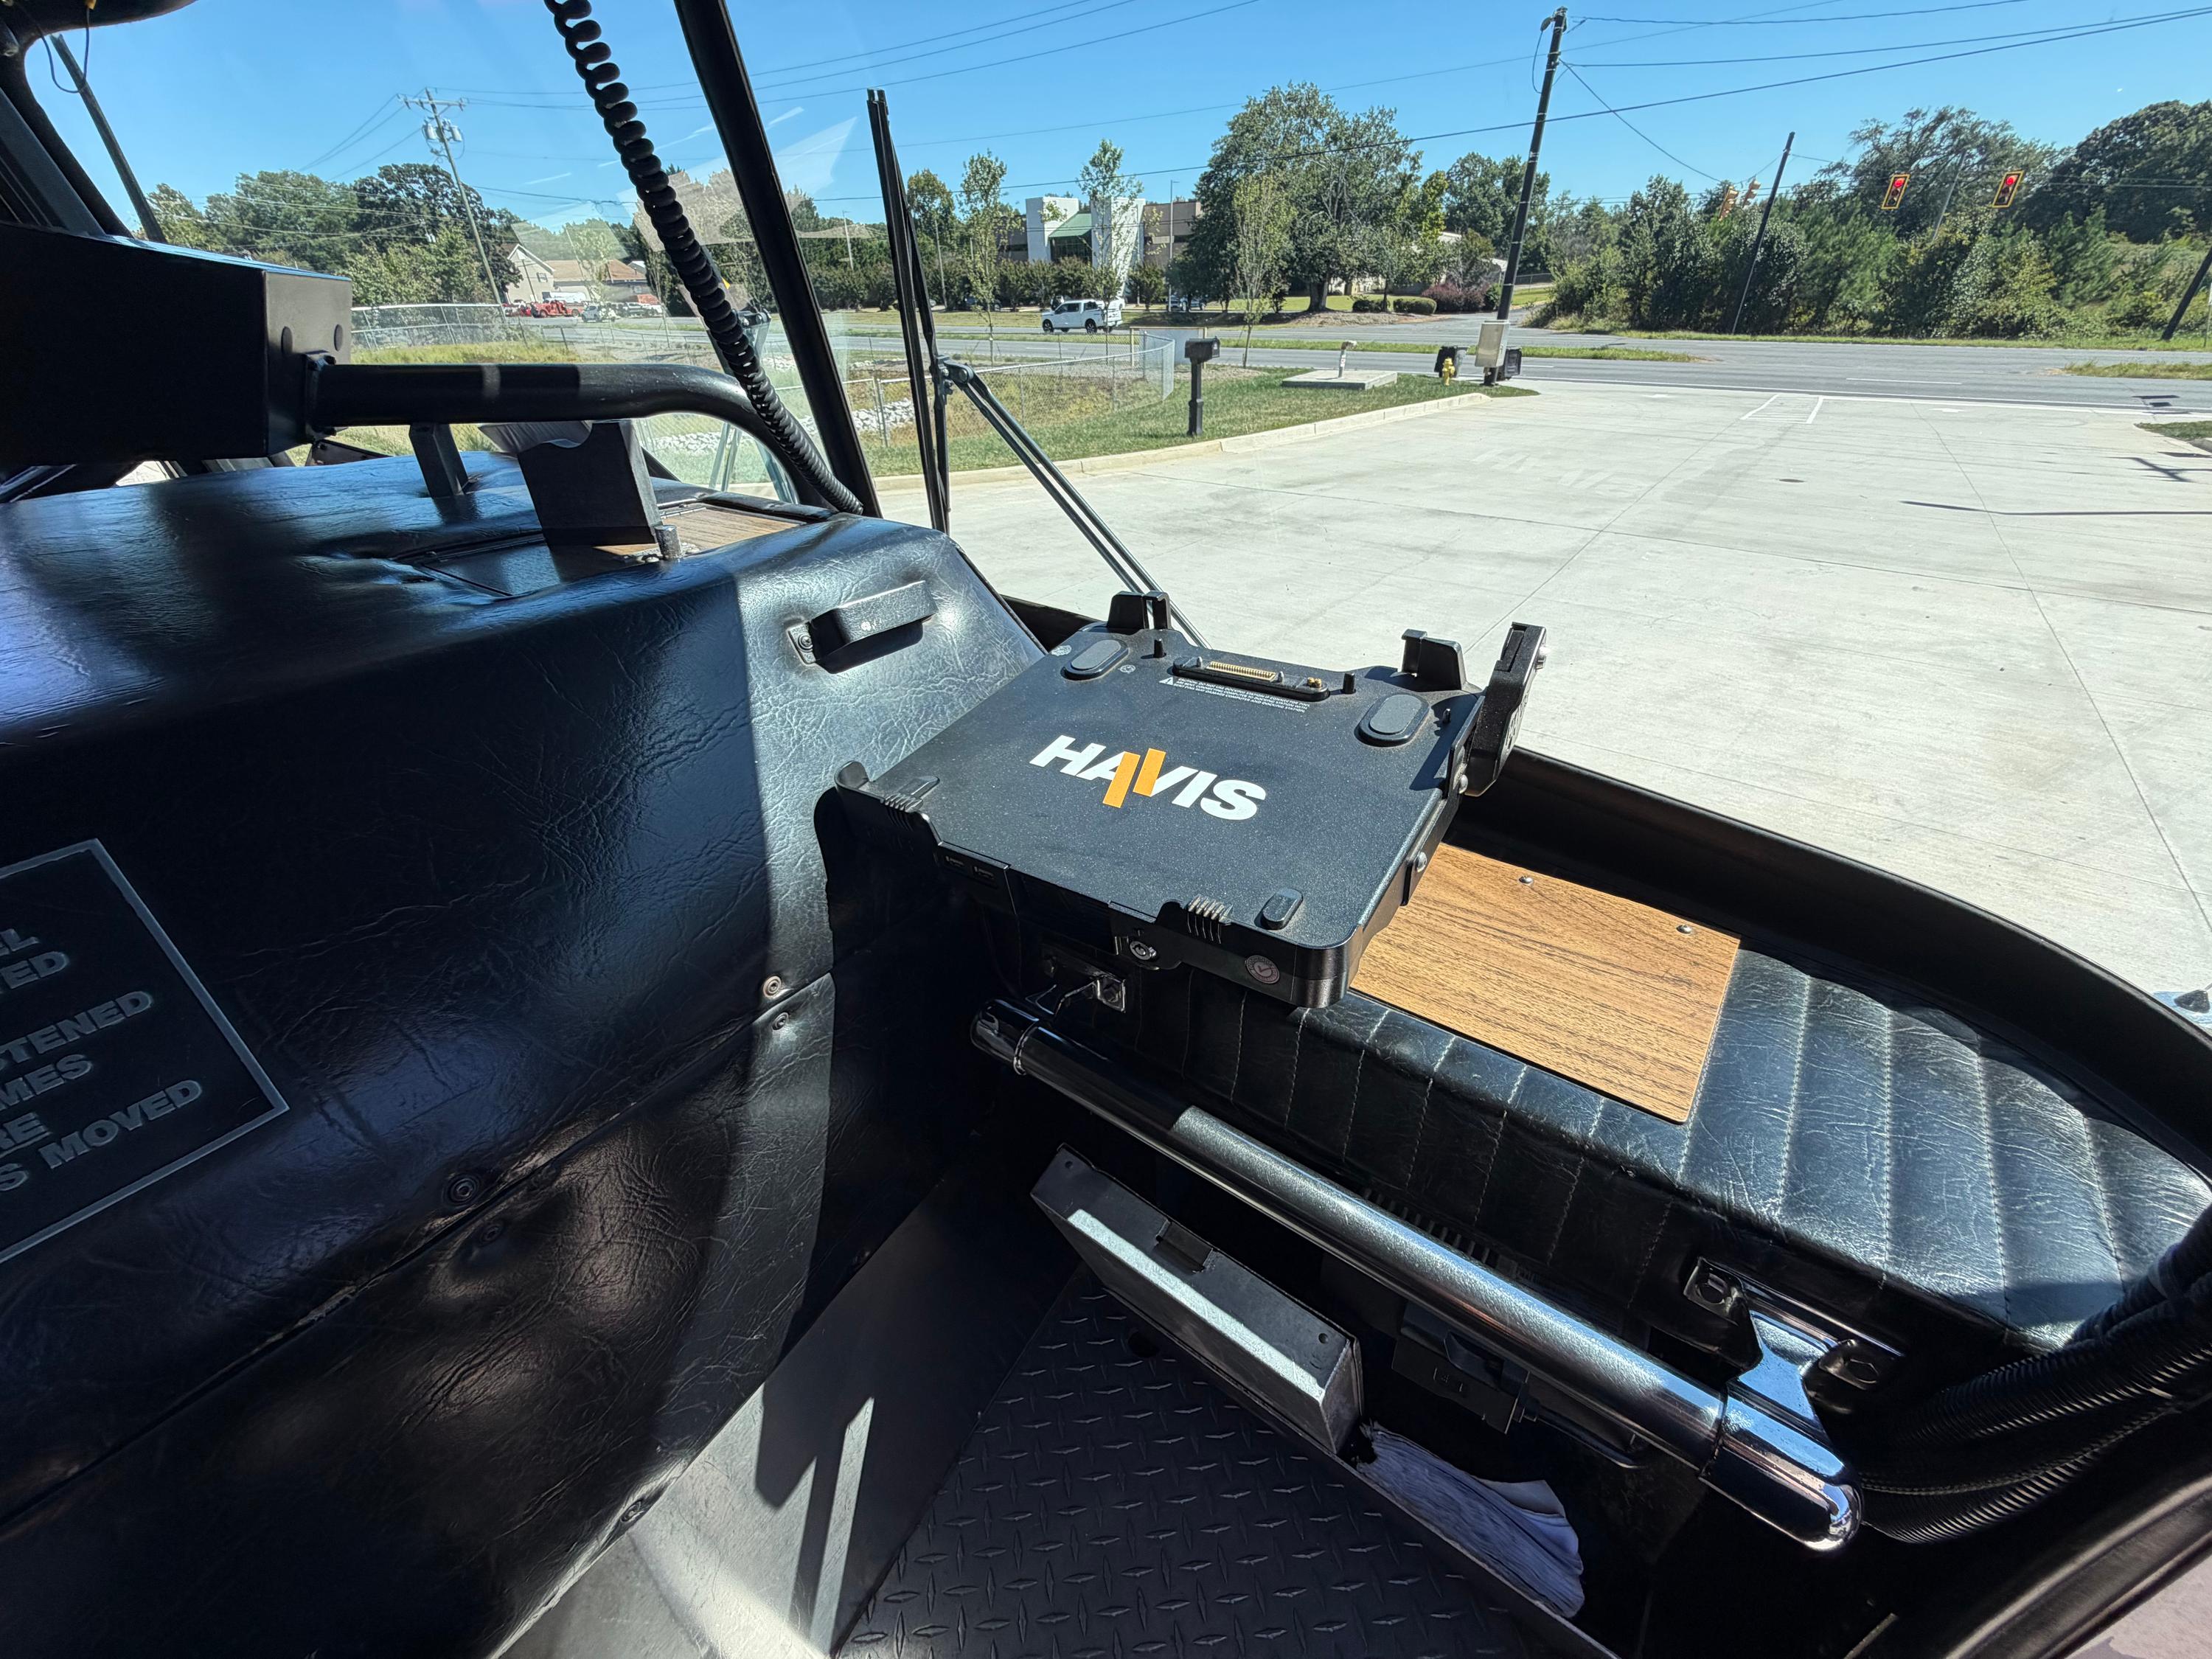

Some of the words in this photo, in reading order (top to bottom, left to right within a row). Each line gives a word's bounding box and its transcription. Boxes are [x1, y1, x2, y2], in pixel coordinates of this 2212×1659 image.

[1029, 734, 1266, 821] HAVIS
[0, 951, 70, 990] ED
[0, 990, 153, 1066] TENED
[38, 1079, 203, 1170] MOVED
